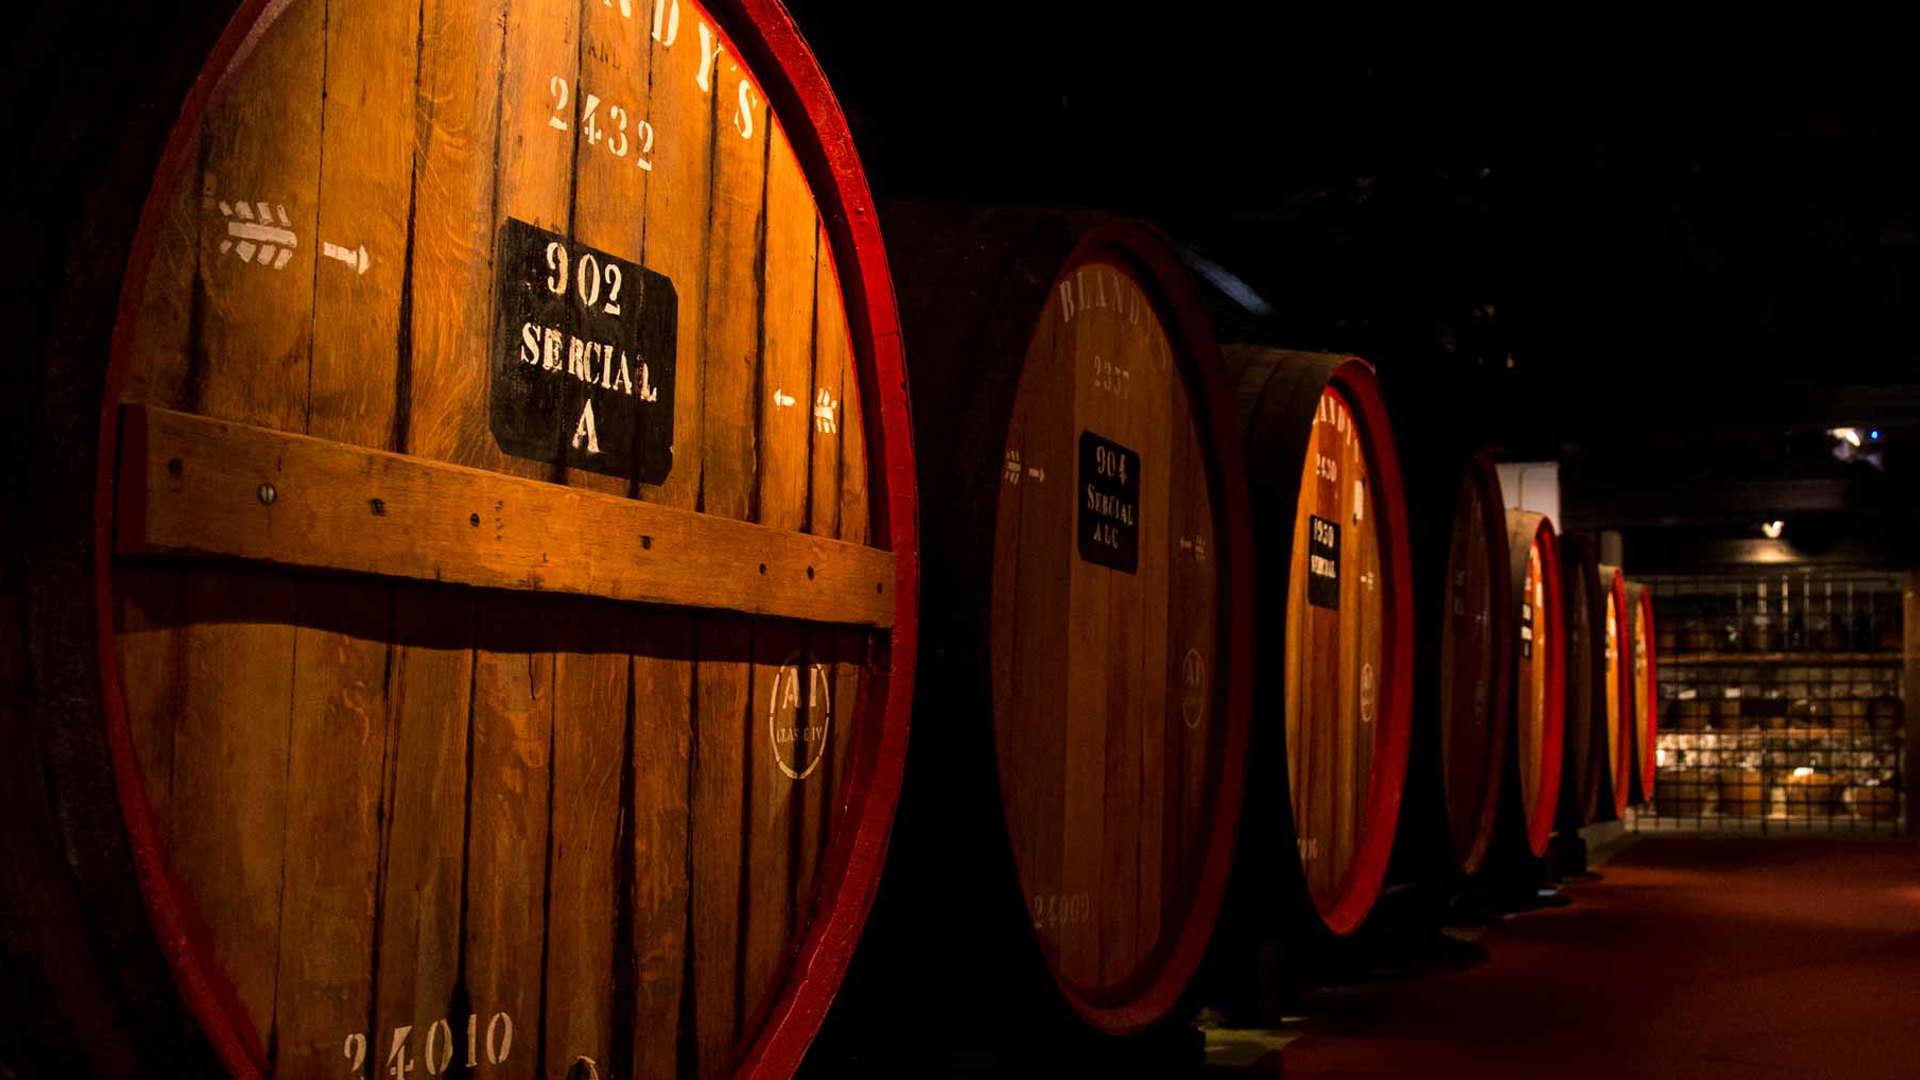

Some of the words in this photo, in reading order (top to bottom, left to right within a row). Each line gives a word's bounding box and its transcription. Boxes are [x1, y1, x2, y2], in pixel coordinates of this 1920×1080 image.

[603, 0, 757, 139] DY'S
[549, 76, 653, 171] 2432
[546, 241, 622, 316] 902
[520, 321, 657, 402] SERCIAL
[572, 398, 600, 454] A
[1096, 445, 1128, 486] 904
[1087, 483, 1135, 527] SERCIAL
[343, 1012, 513, 1080] 24010
